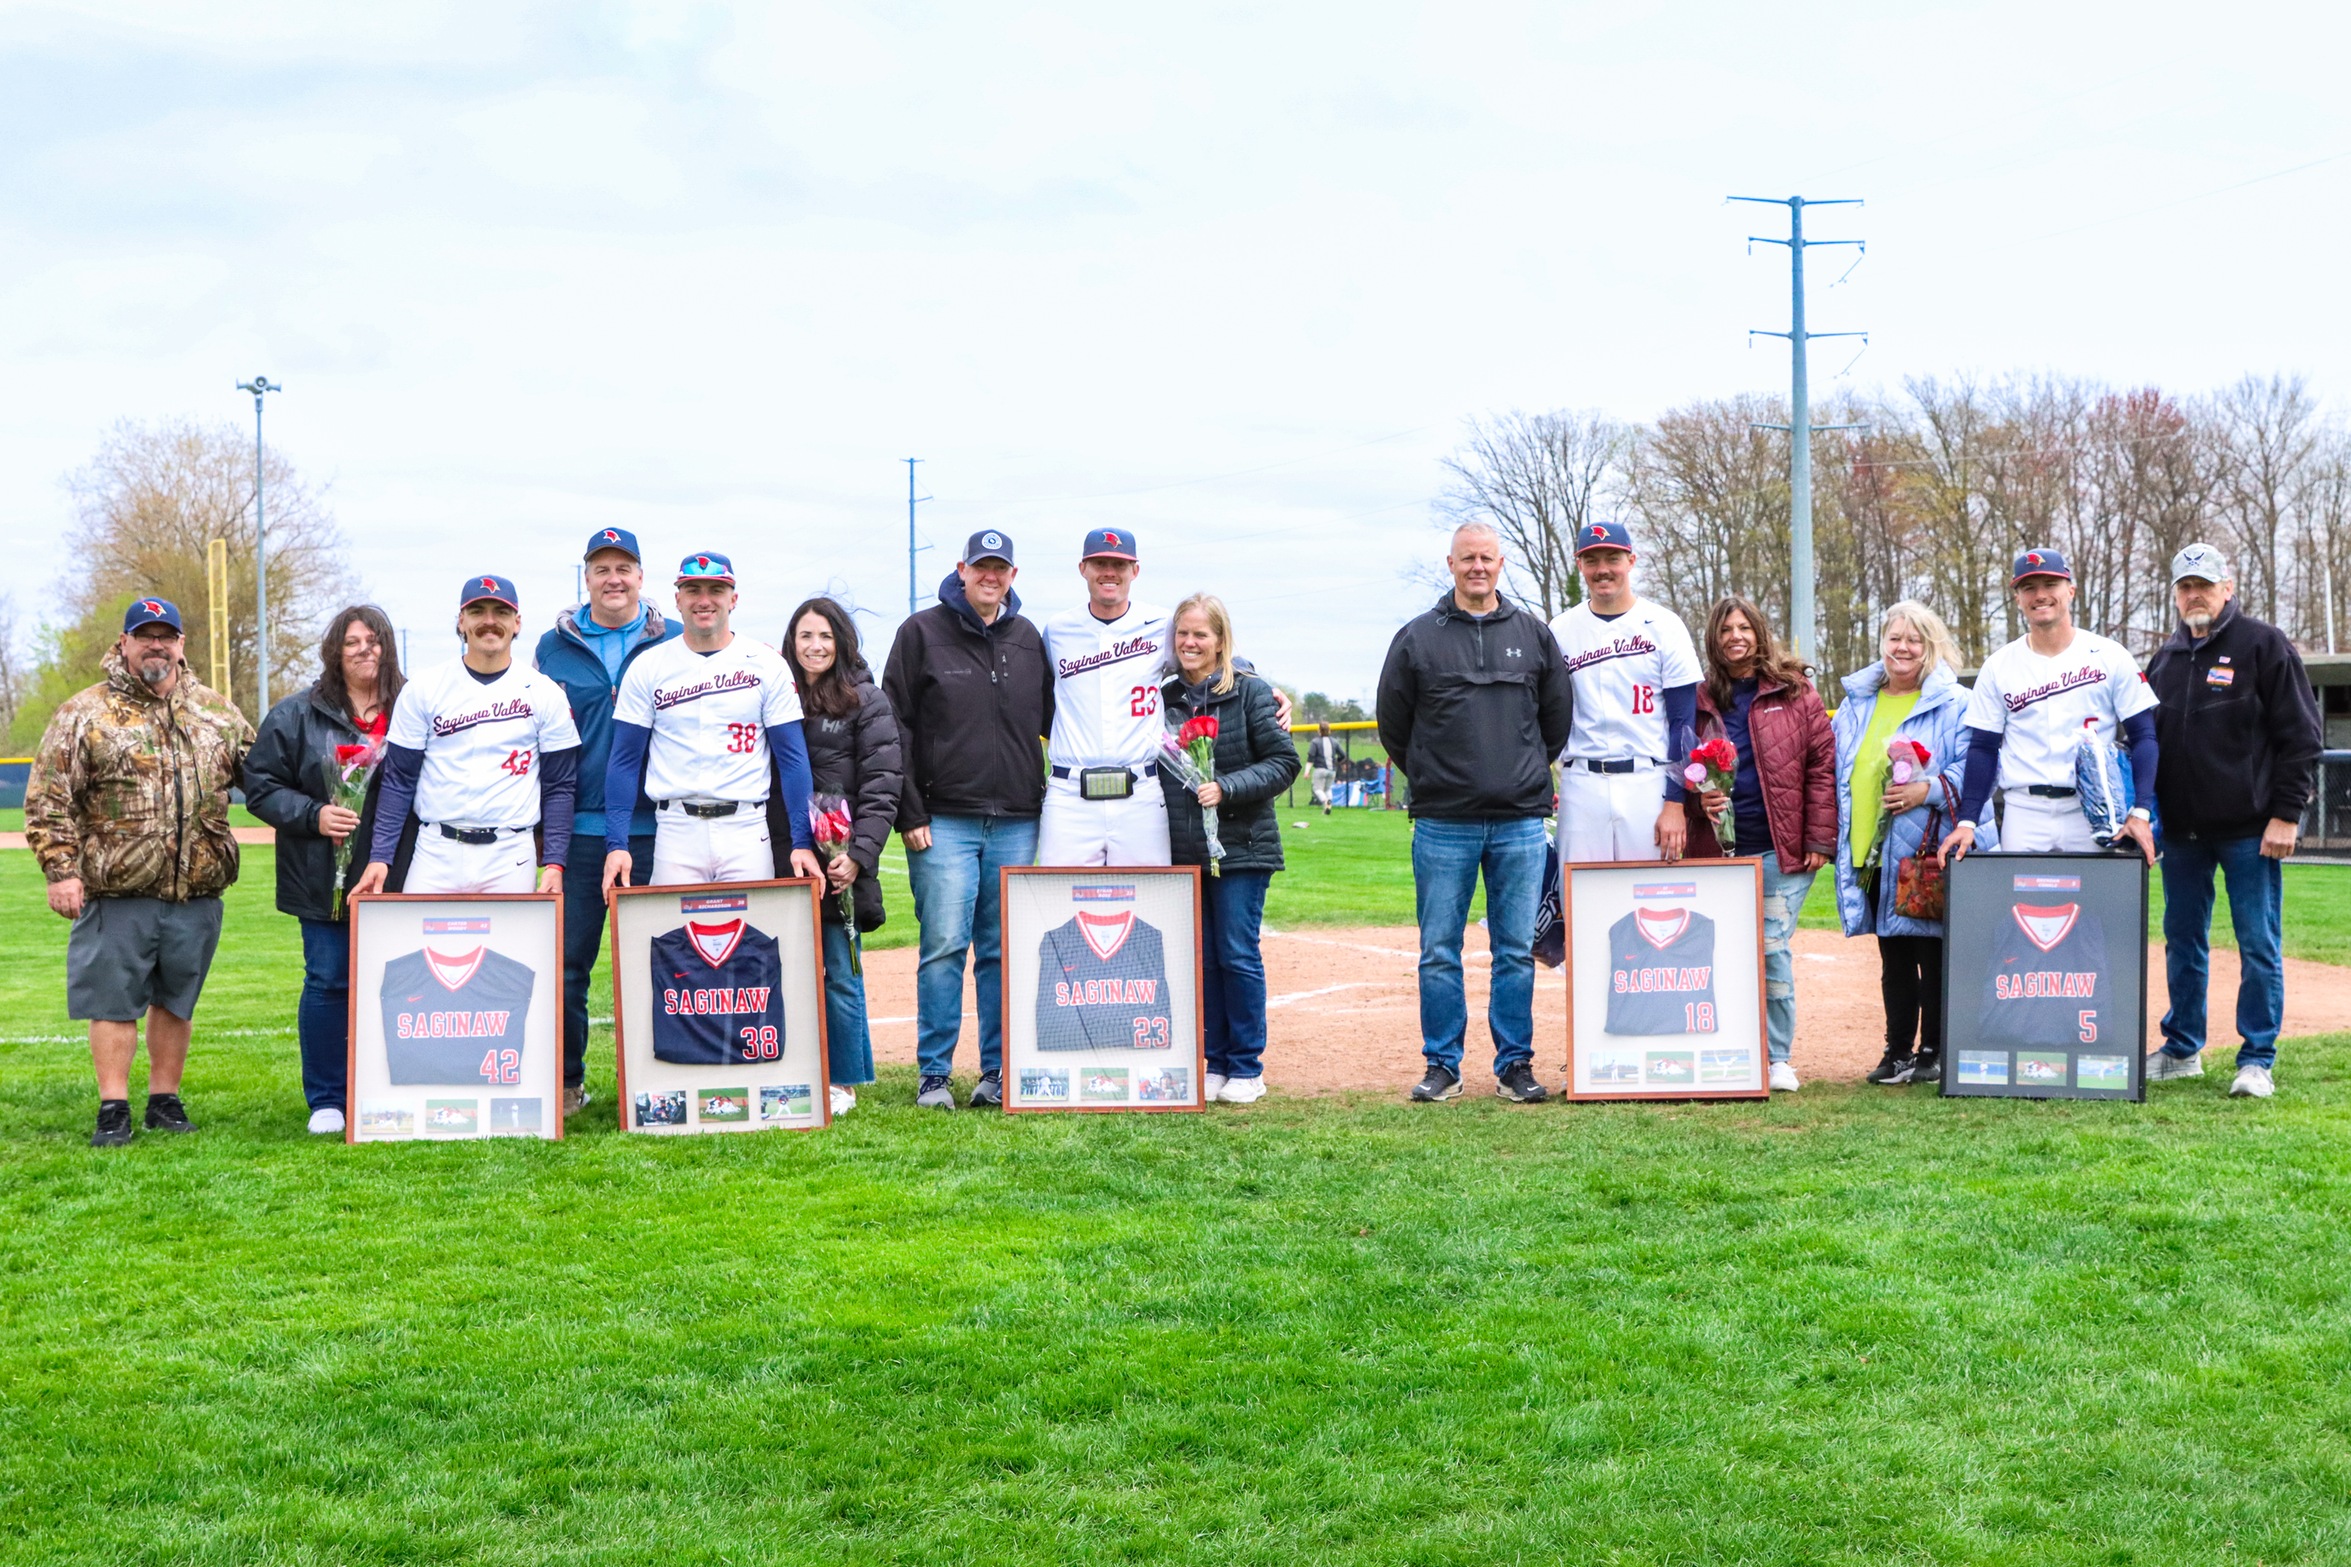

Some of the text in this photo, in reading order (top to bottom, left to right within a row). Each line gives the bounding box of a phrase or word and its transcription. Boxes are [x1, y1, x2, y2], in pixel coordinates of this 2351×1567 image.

[1058, 637, 1157, 675] Saginaw Valley
[1613, 635, 1656, 655] Valley
[653, 670, 760, 707] Saginaw Valley
[1131, 686, 1158, 716] 23
[1632, 684, 1654, 714] 18
[2004, 665, 2106, 709] Saginaw Valley
[433, 698, 533, 734] Saginaw Valley
[727, 722, 757, 753] 38
[501, 750, 532, 775] 42
[1056, 979, 1157, 1006] SAGINAW
[1614, 966, 1711, 993] SAGINAW
[1996, 972, 2096, 999] SAGINAW
[664, 987, 770, 1015] SAGINAW
[397, 1011, 509, 1038] SAGINAW
[1133, 1017, 1168, 1048] 23
[1685, 1002, 1714, 1033] 18
[2079, 1010, 2097, 1043] 5
[740, 1025, 779, 1059] 38
[480, 1049, 520, 1084] 42
